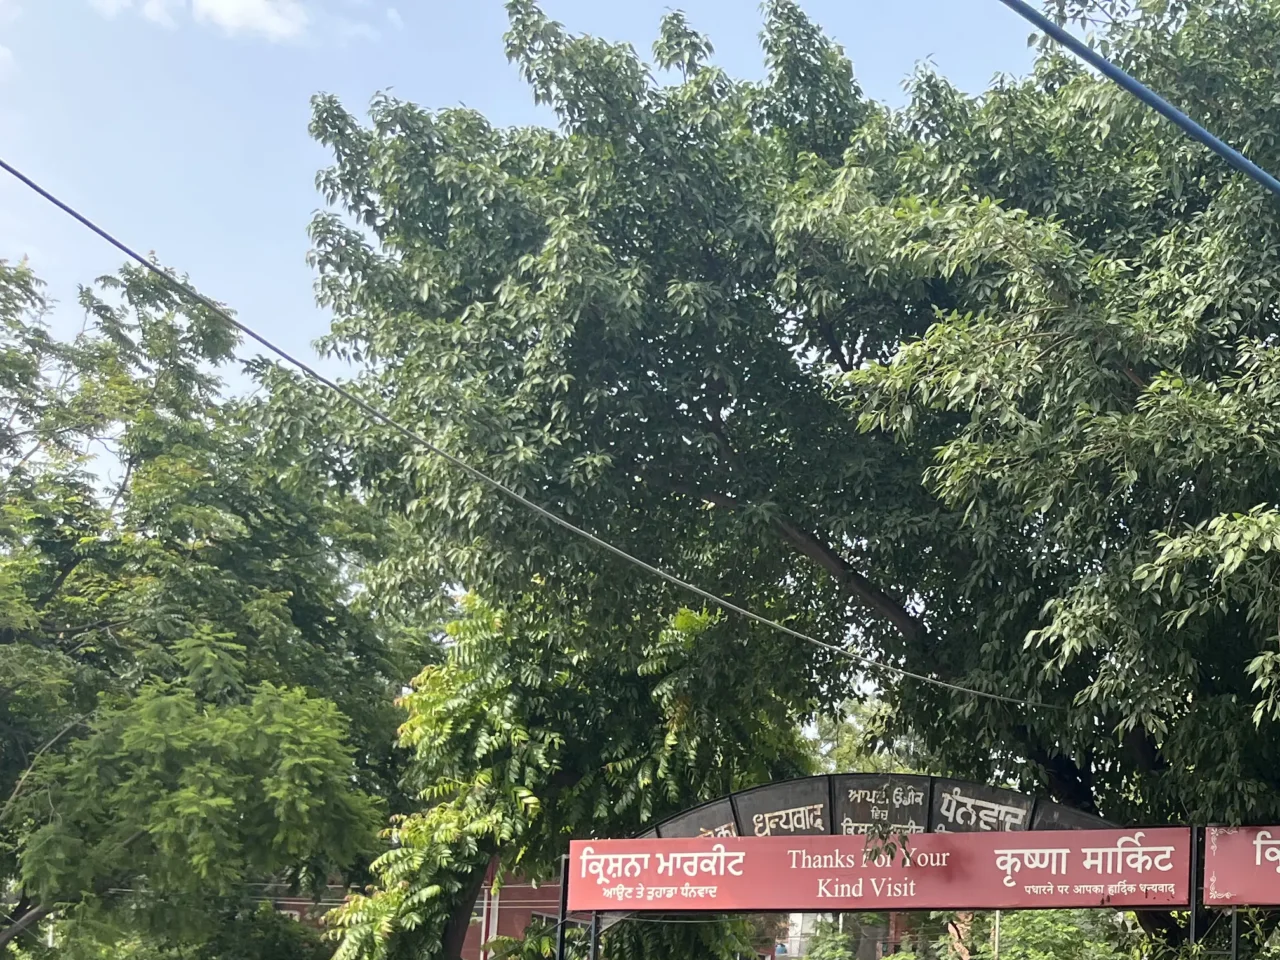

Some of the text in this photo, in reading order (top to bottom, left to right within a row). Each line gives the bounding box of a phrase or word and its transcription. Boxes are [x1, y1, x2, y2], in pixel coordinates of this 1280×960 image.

[655, 843, 746, 876] ਮਾਰਕੀਟ
[787, 848, 855, 869] Thanks
[899, 847, 950, 868] Your
[994, 831, 1176, 888] कृष्णा मार्किट
[816, 877, 916, 898] Kind Visit
[1024, 880, 1175, 896] पधारने पर आपका हार्दिक धन्यवाद
